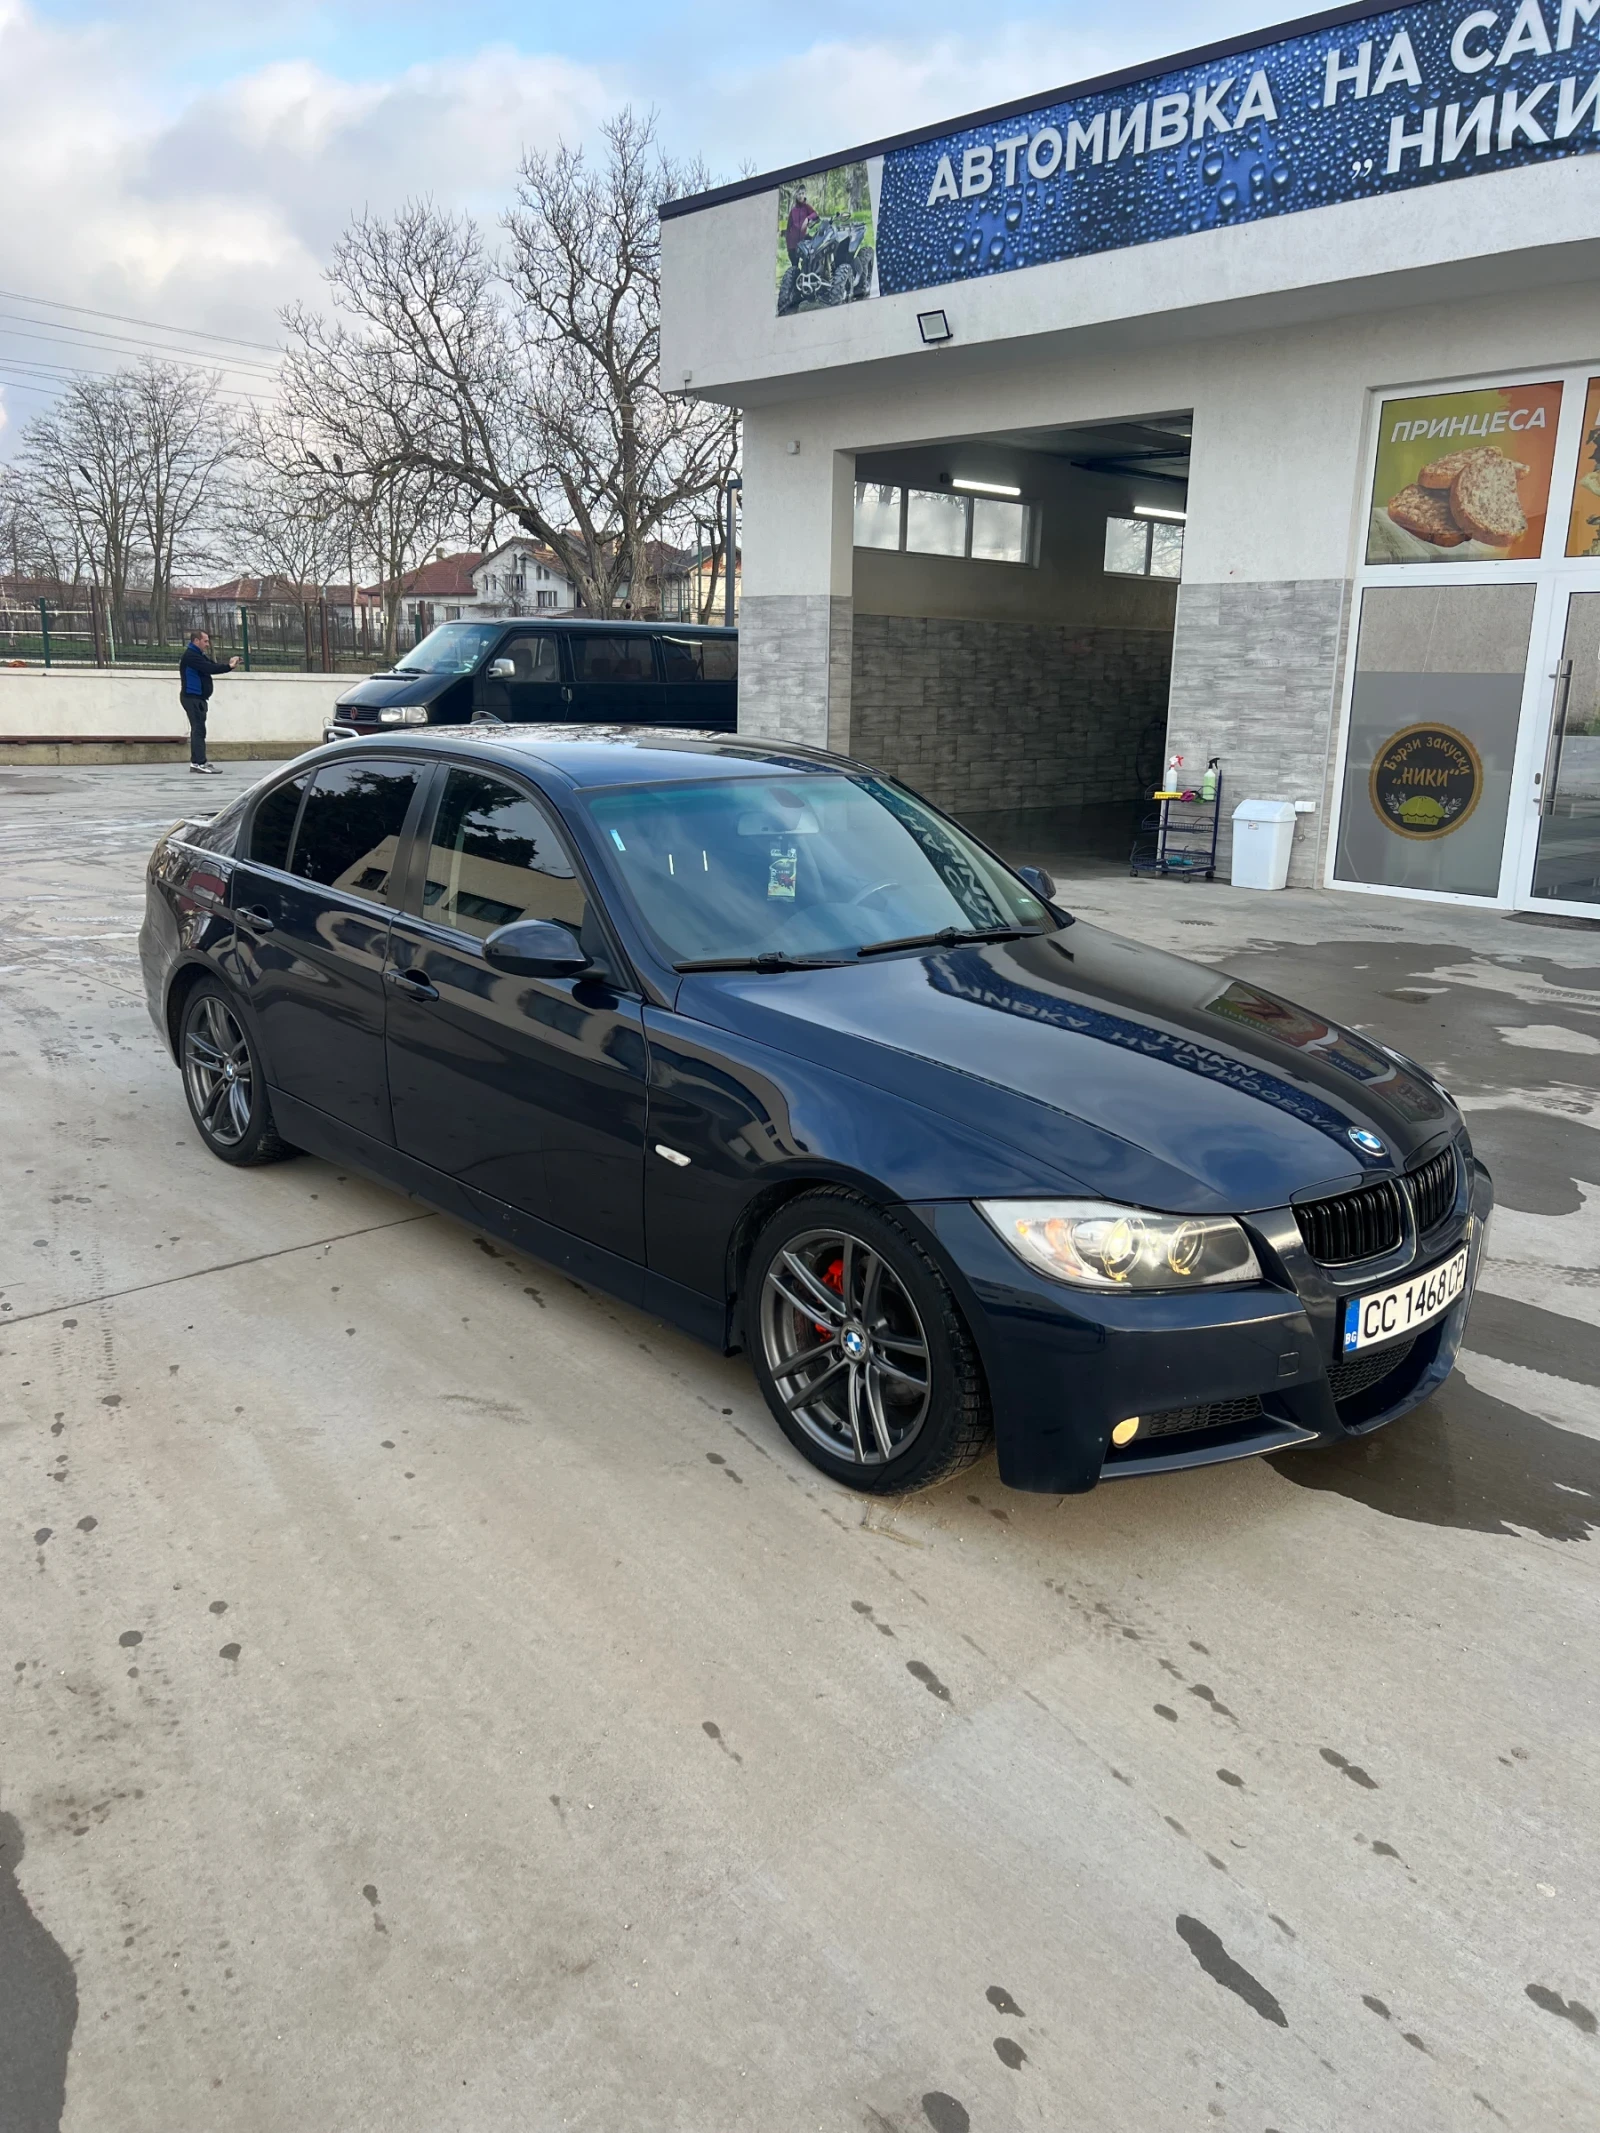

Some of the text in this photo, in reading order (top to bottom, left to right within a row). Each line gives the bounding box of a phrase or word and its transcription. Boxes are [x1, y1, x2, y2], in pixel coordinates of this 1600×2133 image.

[926, 70, 1278, 207] АВТОМИВКА
[1323, 31, 1422, 107] НА
[1390, 407, 1547, 443] ПРИНЦЕСА
[1383, 736, 1471, 775] Бързи закуски
[1405, 1269, 1446, 1324] 1468
[1345, 1331, 1357, 1345] BG
